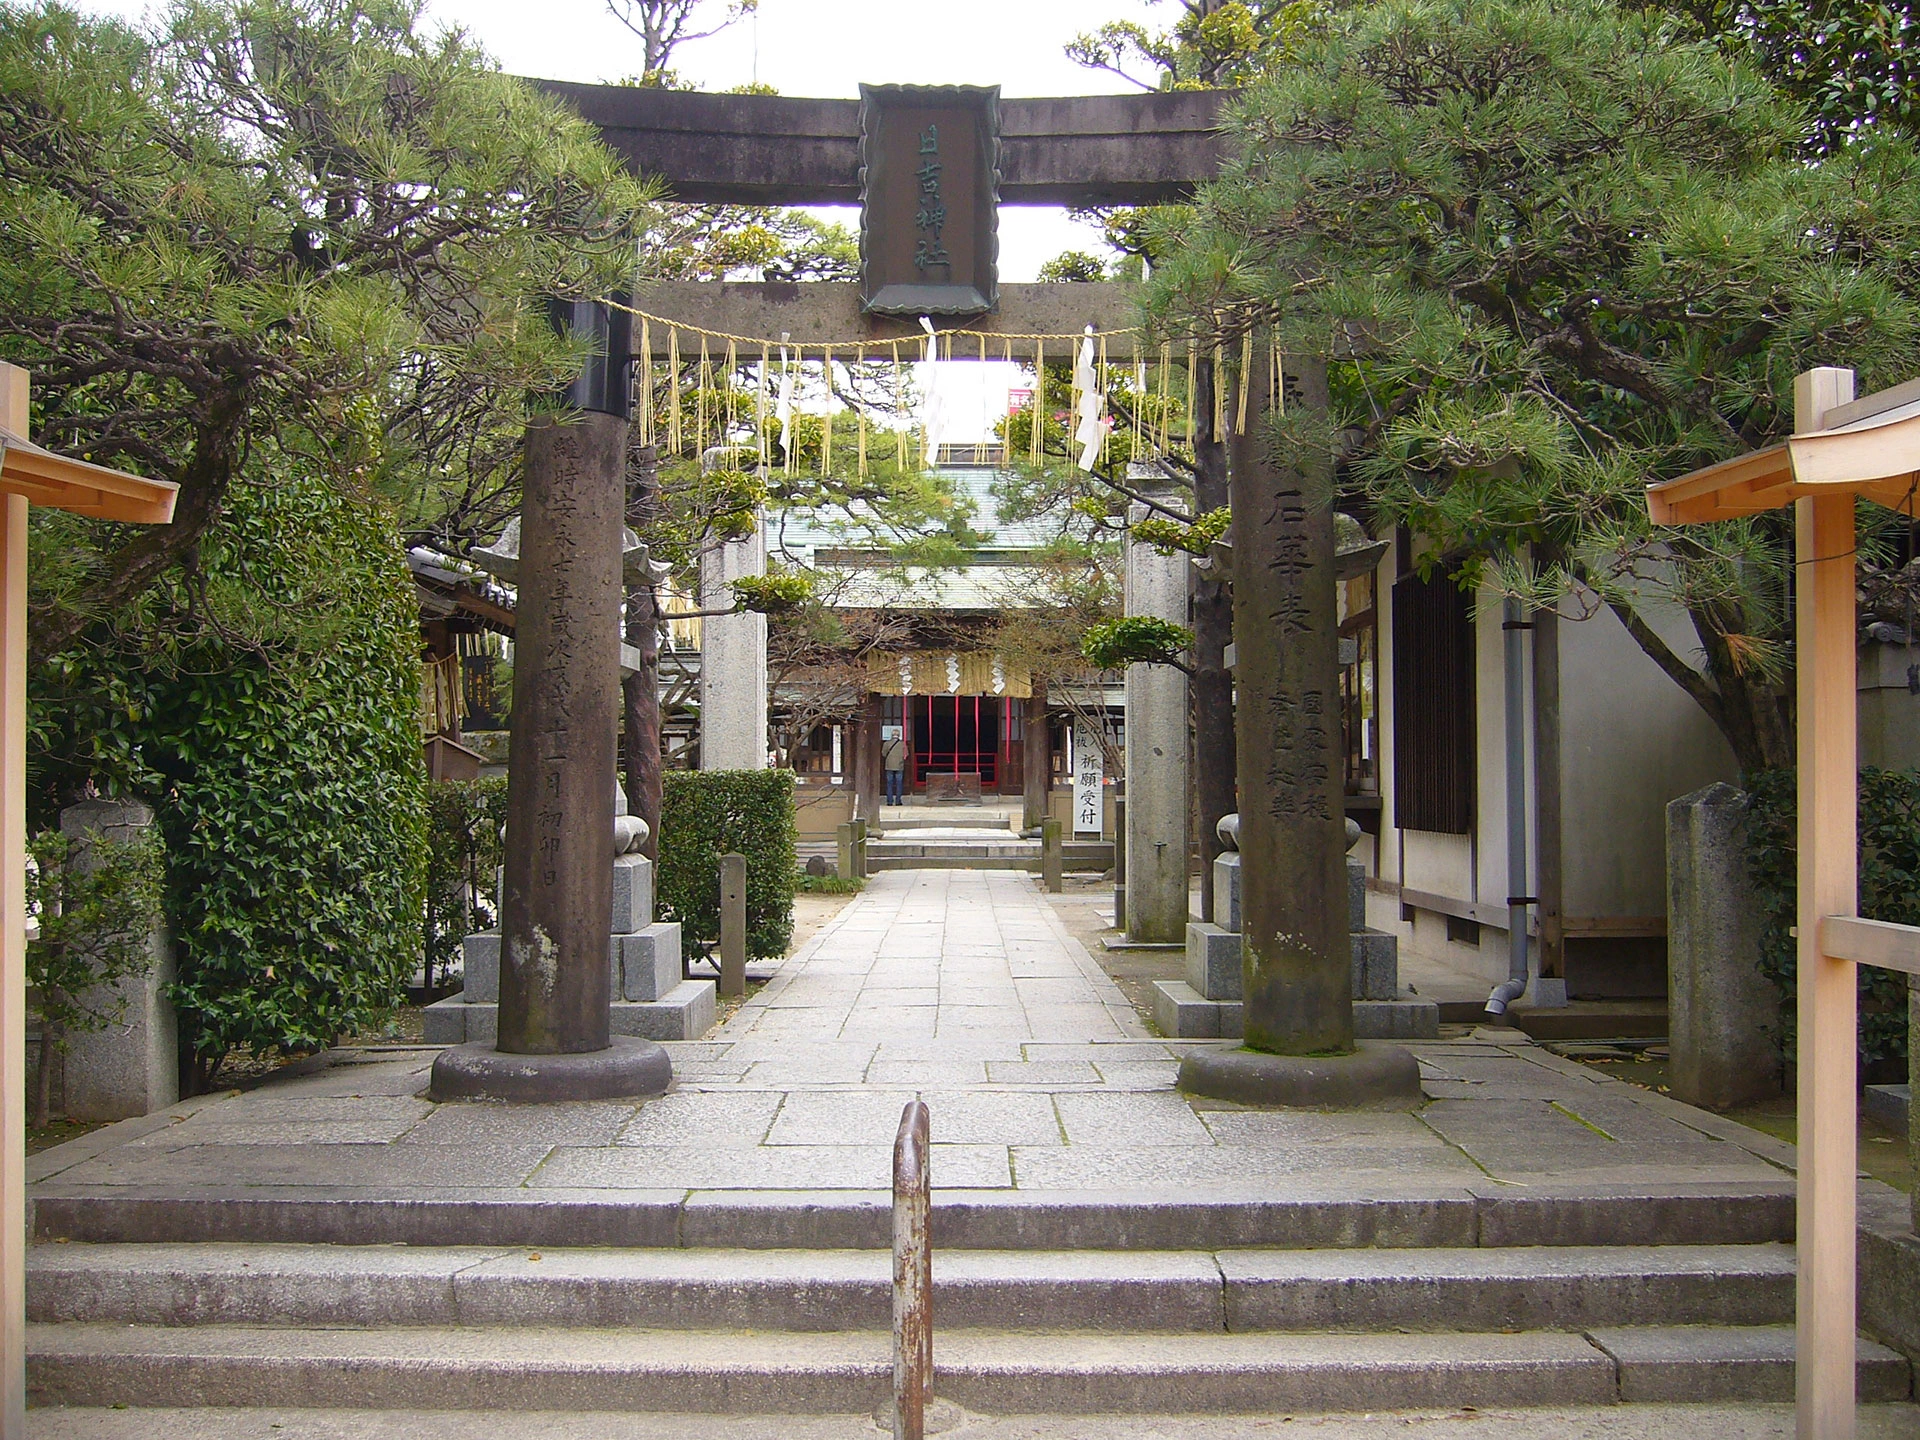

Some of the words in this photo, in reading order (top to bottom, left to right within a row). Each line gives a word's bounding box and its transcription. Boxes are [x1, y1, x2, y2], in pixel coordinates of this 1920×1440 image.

[914, 124, 950, 271] 日吉神社
[1080, 755, 1099, 824] 祈願受付
